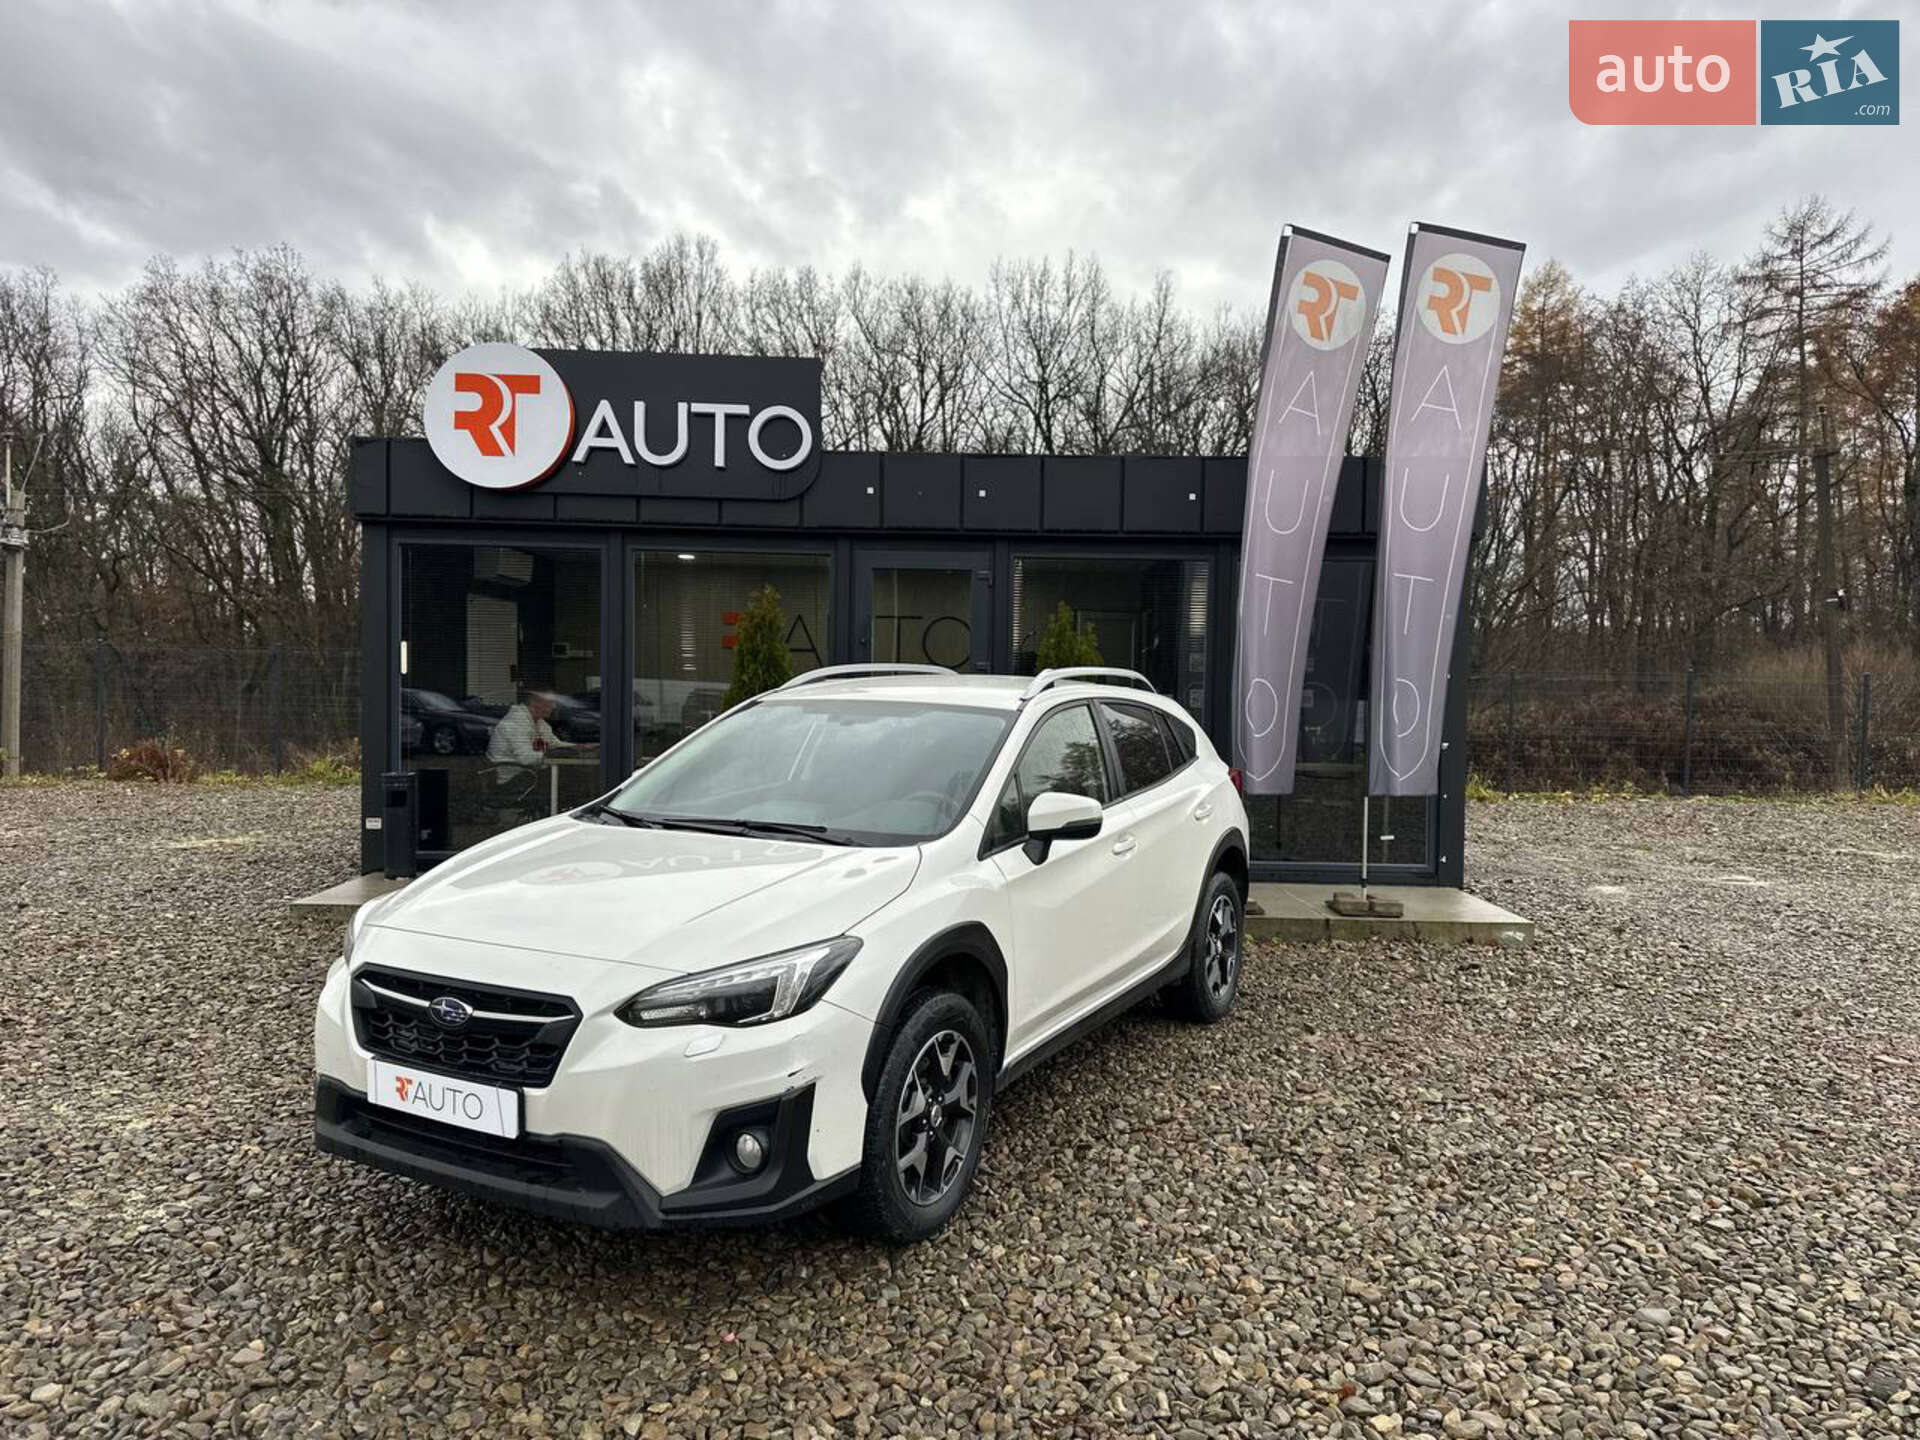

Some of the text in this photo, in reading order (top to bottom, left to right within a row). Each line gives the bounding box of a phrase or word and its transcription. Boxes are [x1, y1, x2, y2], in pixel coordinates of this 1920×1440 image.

[1297, 270, 1360, 343] RT
[1427, 266, 1494, 336] RT
[454, 372, 813, 471] RT AUTO
[785, 613, 972, 669] ATO
[411, 1081, 484, 1120] AUTO
